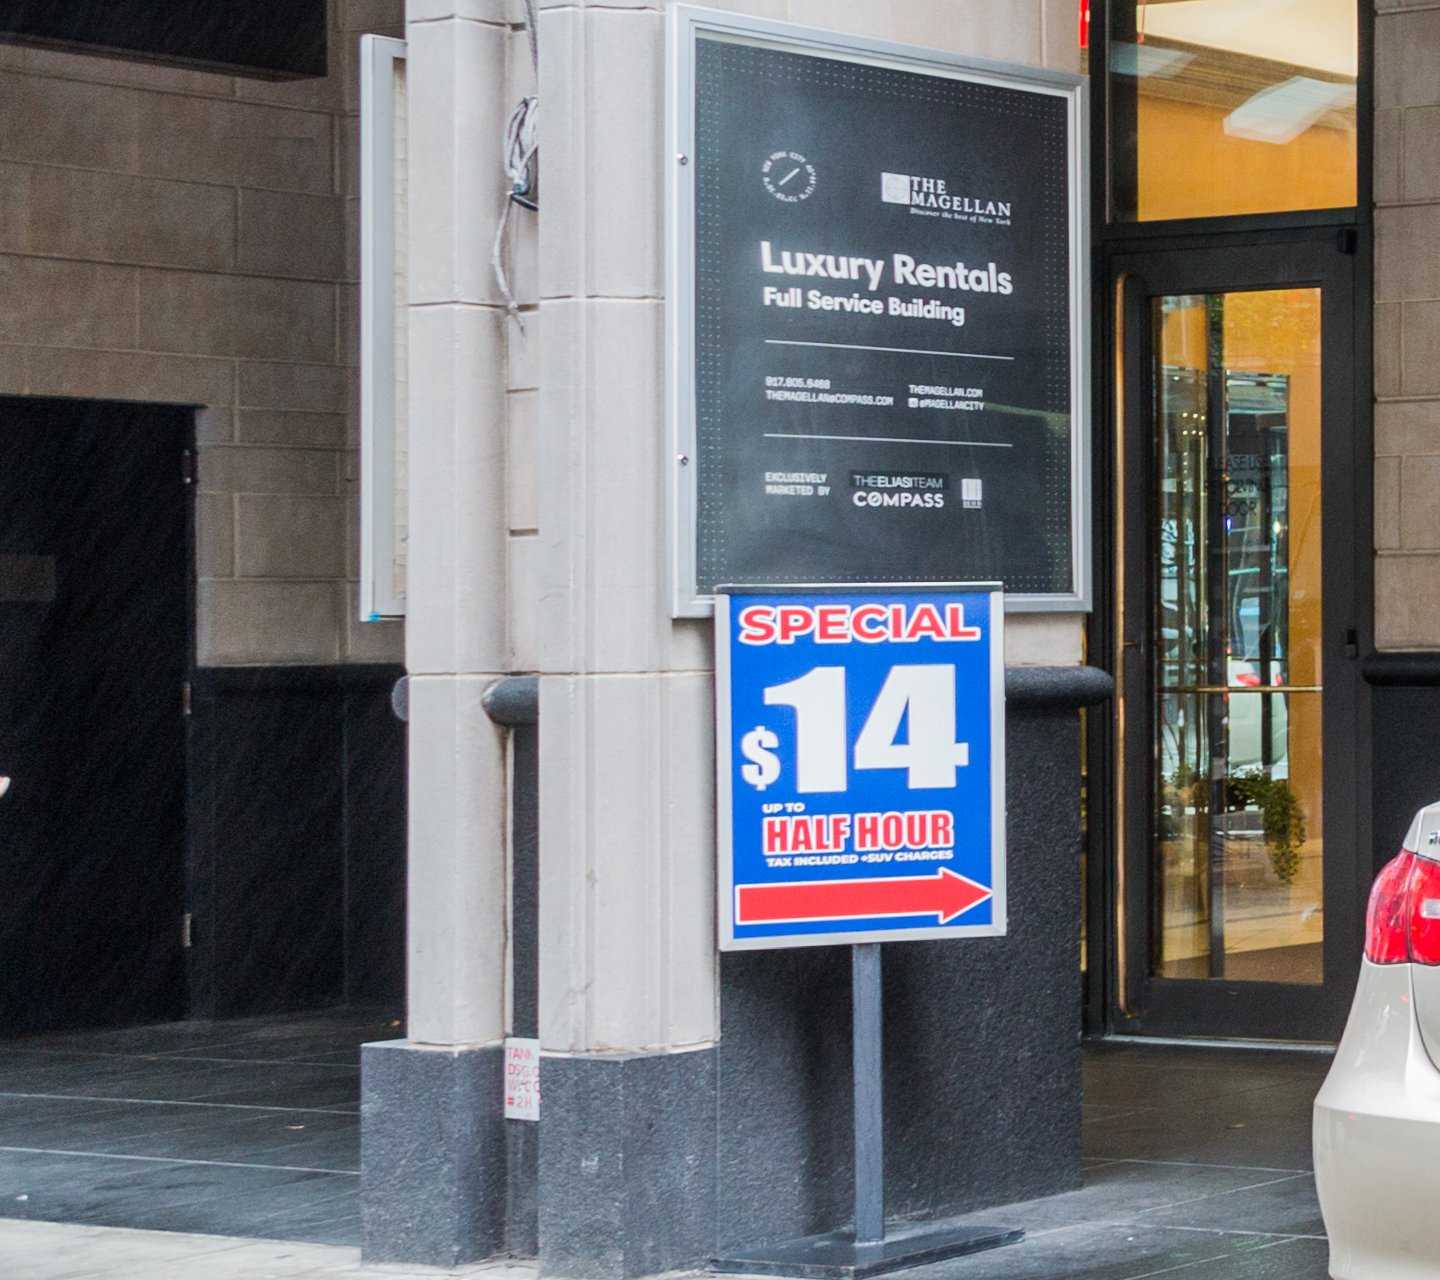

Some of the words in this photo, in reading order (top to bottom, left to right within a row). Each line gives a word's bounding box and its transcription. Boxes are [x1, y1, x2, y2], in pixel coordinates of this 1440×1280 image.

[911, 176, 945, 194] THE
[911, 191, 1011, 216] MAGELLAN
[761, 241, 884, 291] Luxury
[893, 254, 1013, 295] Rentals
[764, 287, 802, 308] Full
[808, 290, 883, 315] Service
[888, 297, 965, 326] Building
[853, 491, 944, 507] COMPASS
[739, 603, 981, 645] SPECIAL
[762, 803, 783, 814] UP
[784, 802, 805, 813] TO
[762, 814, 852, 855] HALF
[854, 810, 954, 853] HOUR
[766, 857, 792, 868] TAX
[794, 854, 859, 866] INCLUDED
[895, 849, 954, 862] CHARGES
